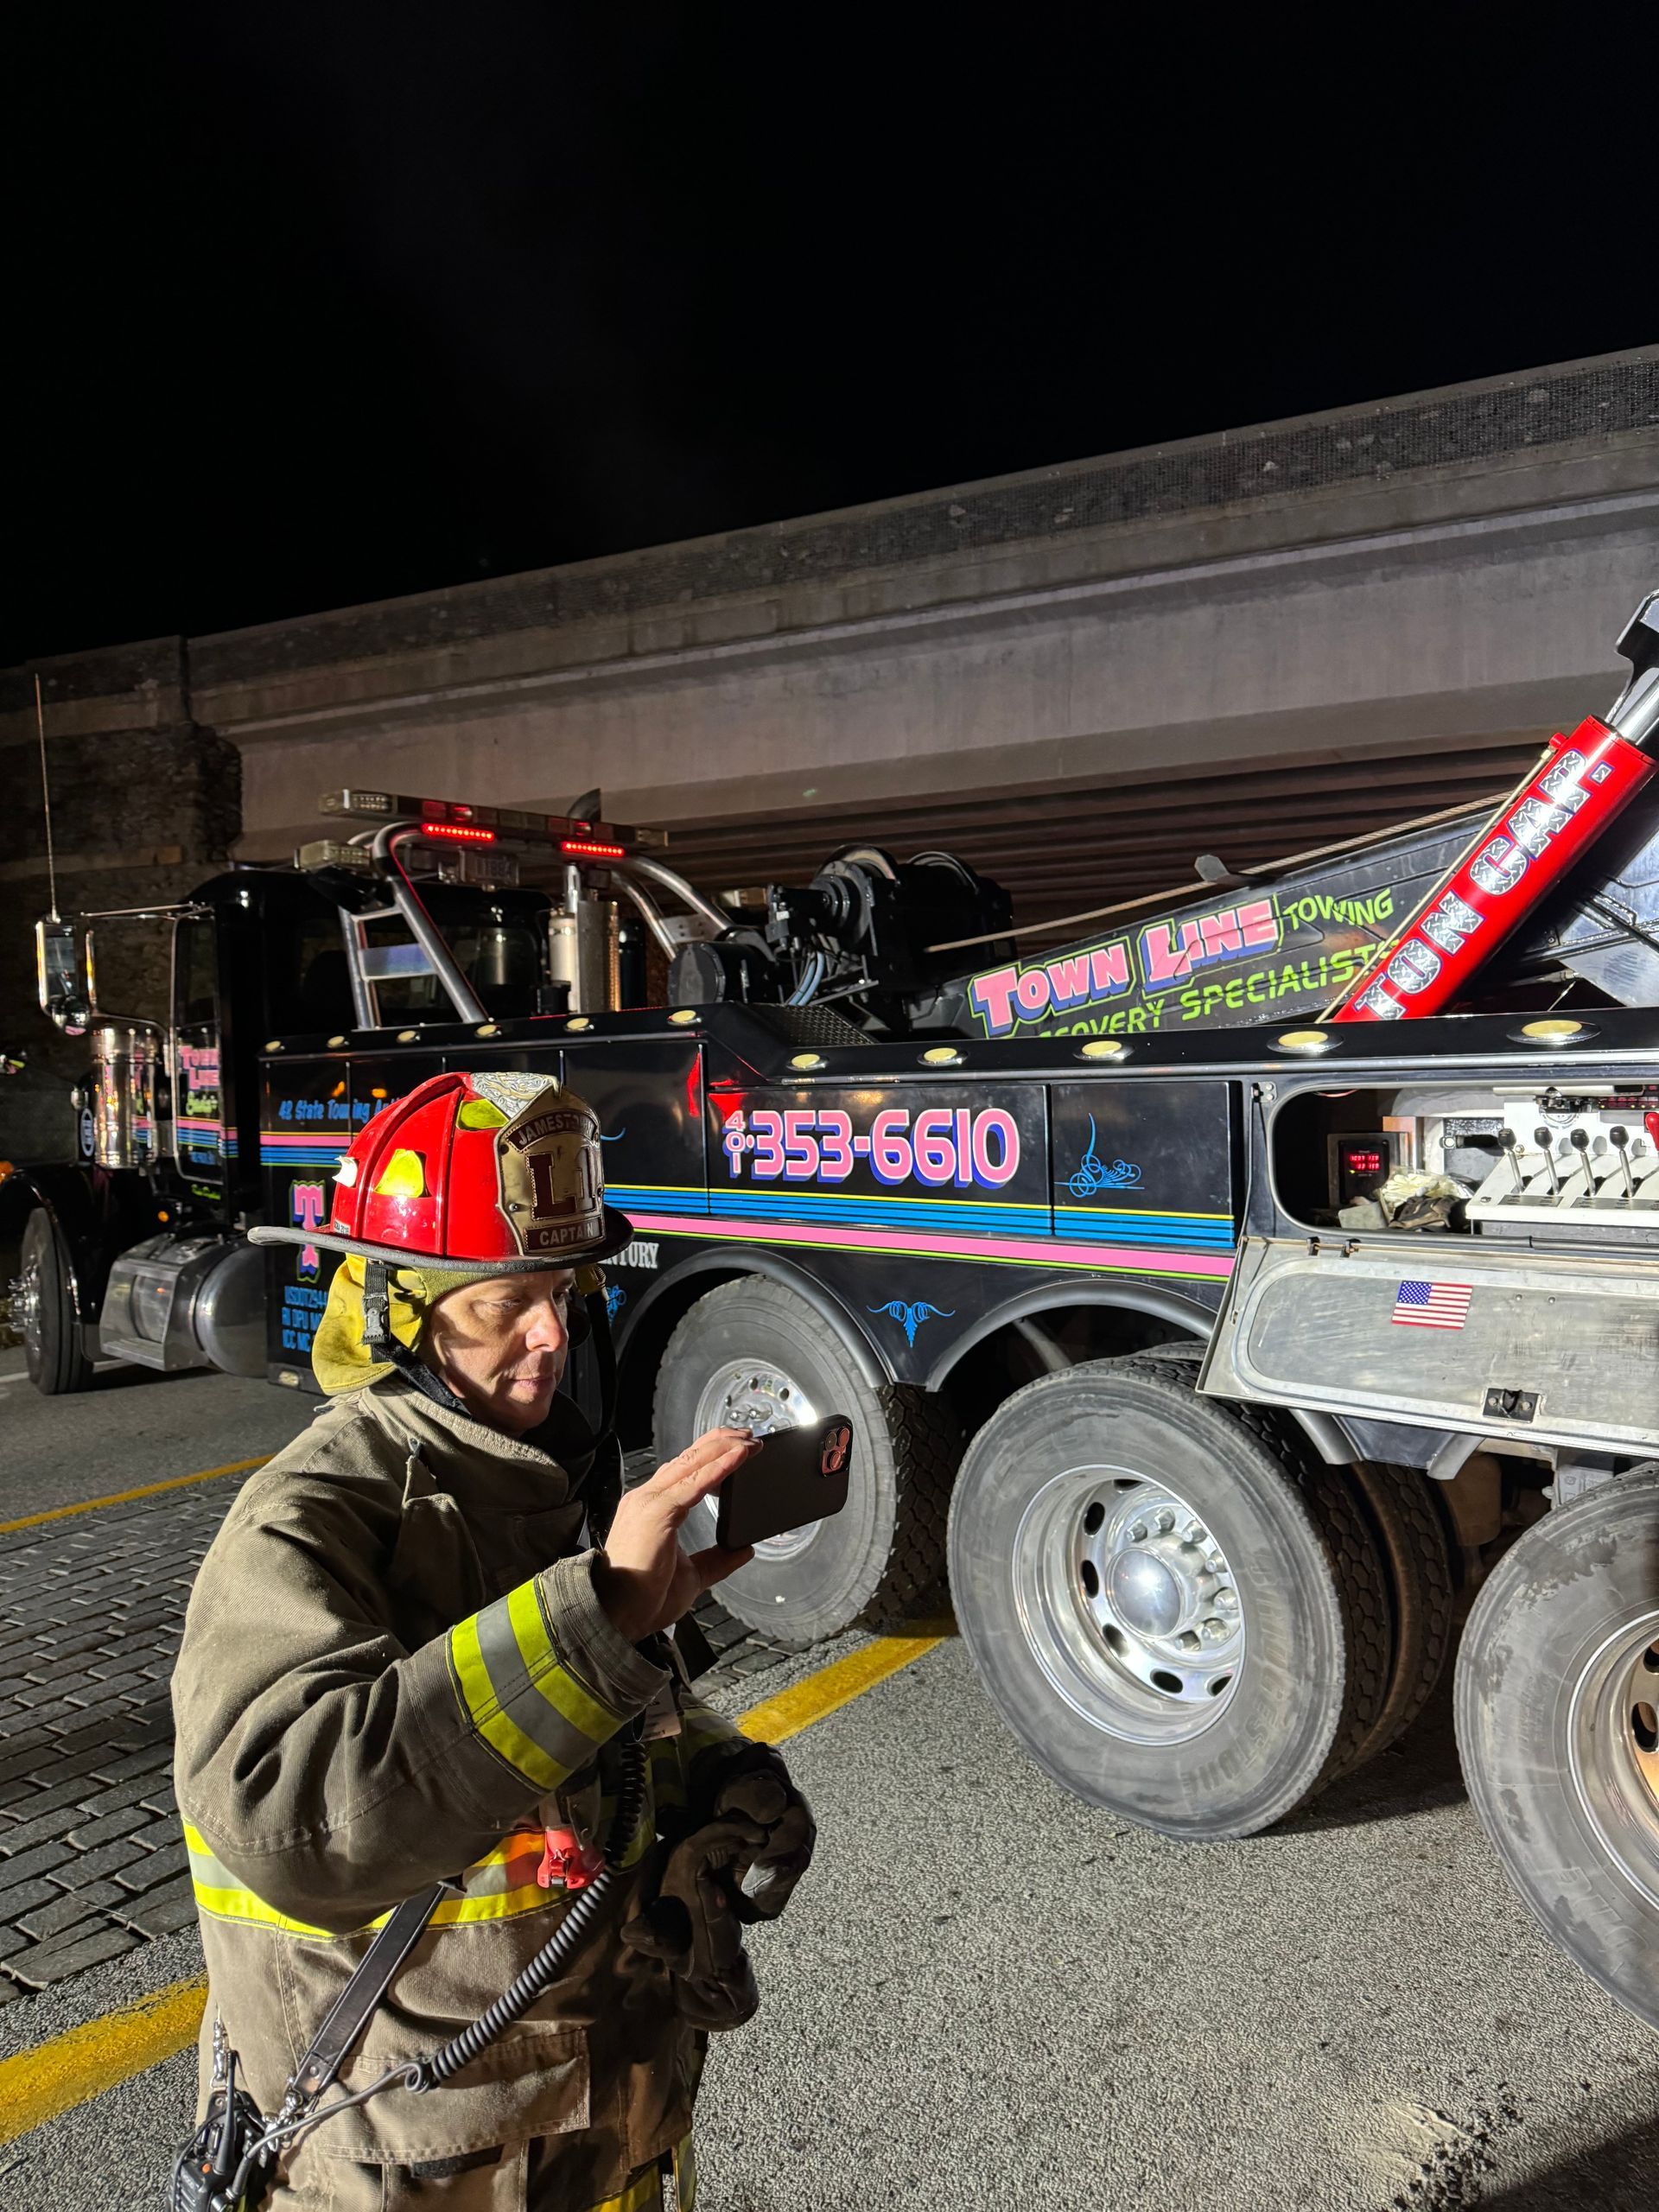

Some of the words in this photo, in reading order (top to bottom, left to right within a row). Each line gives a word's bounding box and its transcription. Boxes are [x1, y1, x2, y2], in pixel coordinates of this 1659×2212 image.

[1282, 888, 1393, 931] TOWING
[750, 1108, 1020, 1183] 353-6610
[539, 1222, 594, 1247] CAPTAIN
